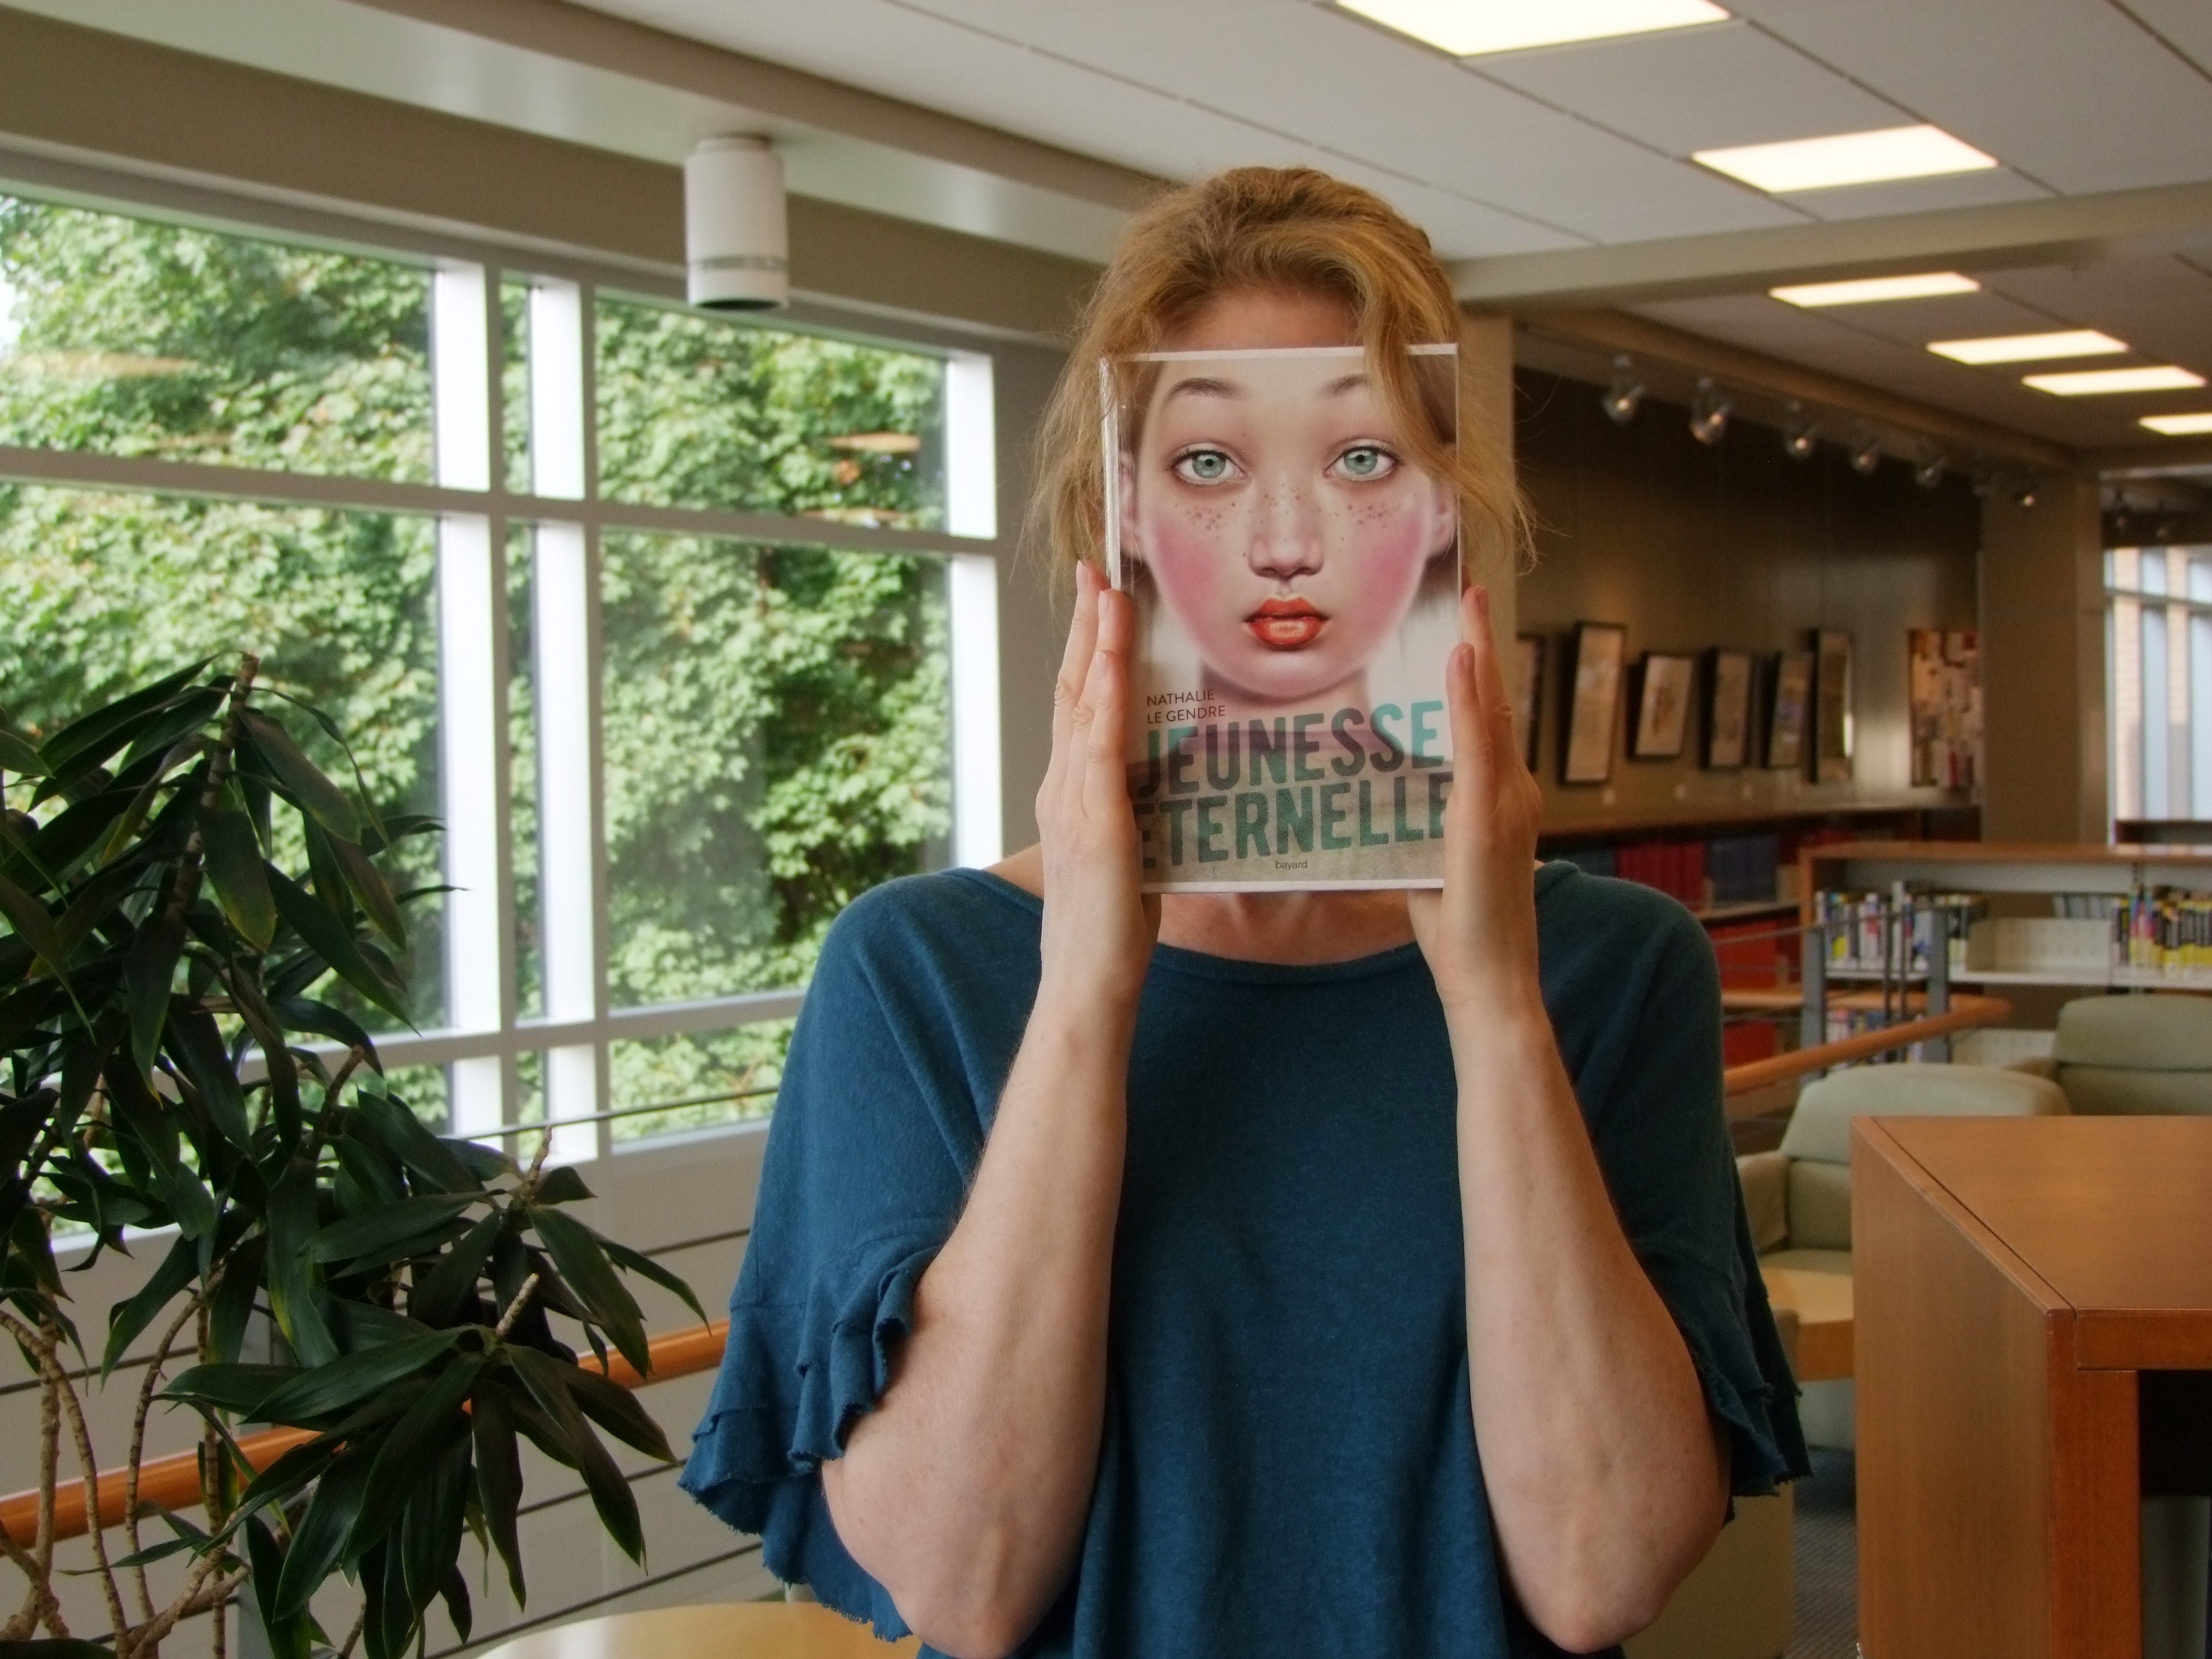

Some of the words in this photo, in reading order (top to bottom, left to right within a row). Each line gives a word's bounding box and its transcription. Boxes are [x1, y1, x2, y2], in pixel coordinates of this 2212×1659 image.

[1147, 690, 1214, 706] NATHALIE
[1147, 711, 1162, 724] LE
[1166, 705, 1225, 722] GENDRE
[1137, 700, 1444, 798] JEUNESSE
[1275, 861, 1307, 870] bayard
